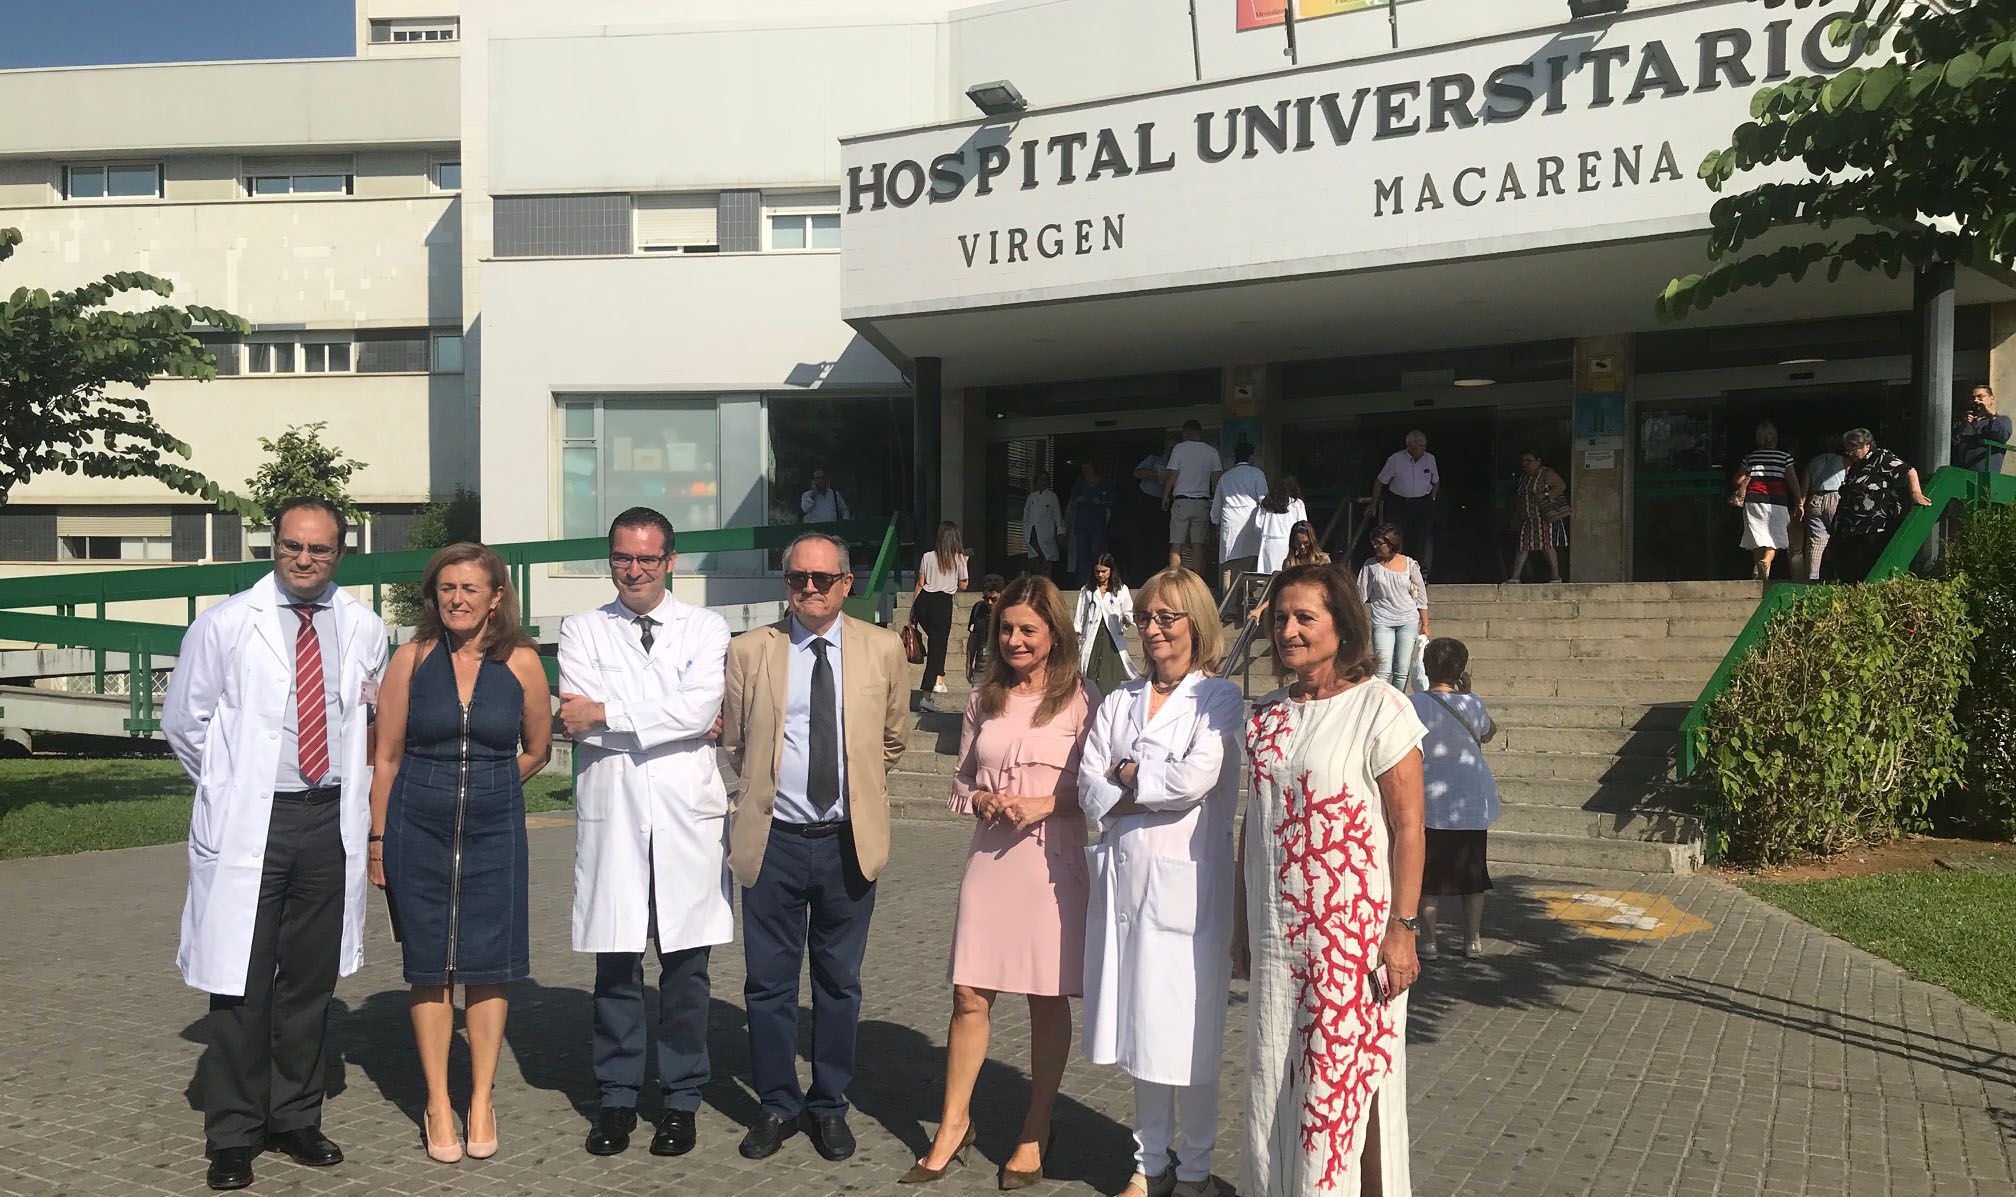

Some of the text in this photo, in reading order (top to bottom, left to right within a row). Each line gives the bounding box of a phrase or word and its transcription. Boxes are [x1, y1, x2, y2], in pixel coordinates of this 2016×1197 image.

[847, 11, 1868, 213] HOSPITAL UNIVERSITARIO
[958, 141, 1683, 268] VIRGEN MACARENA
